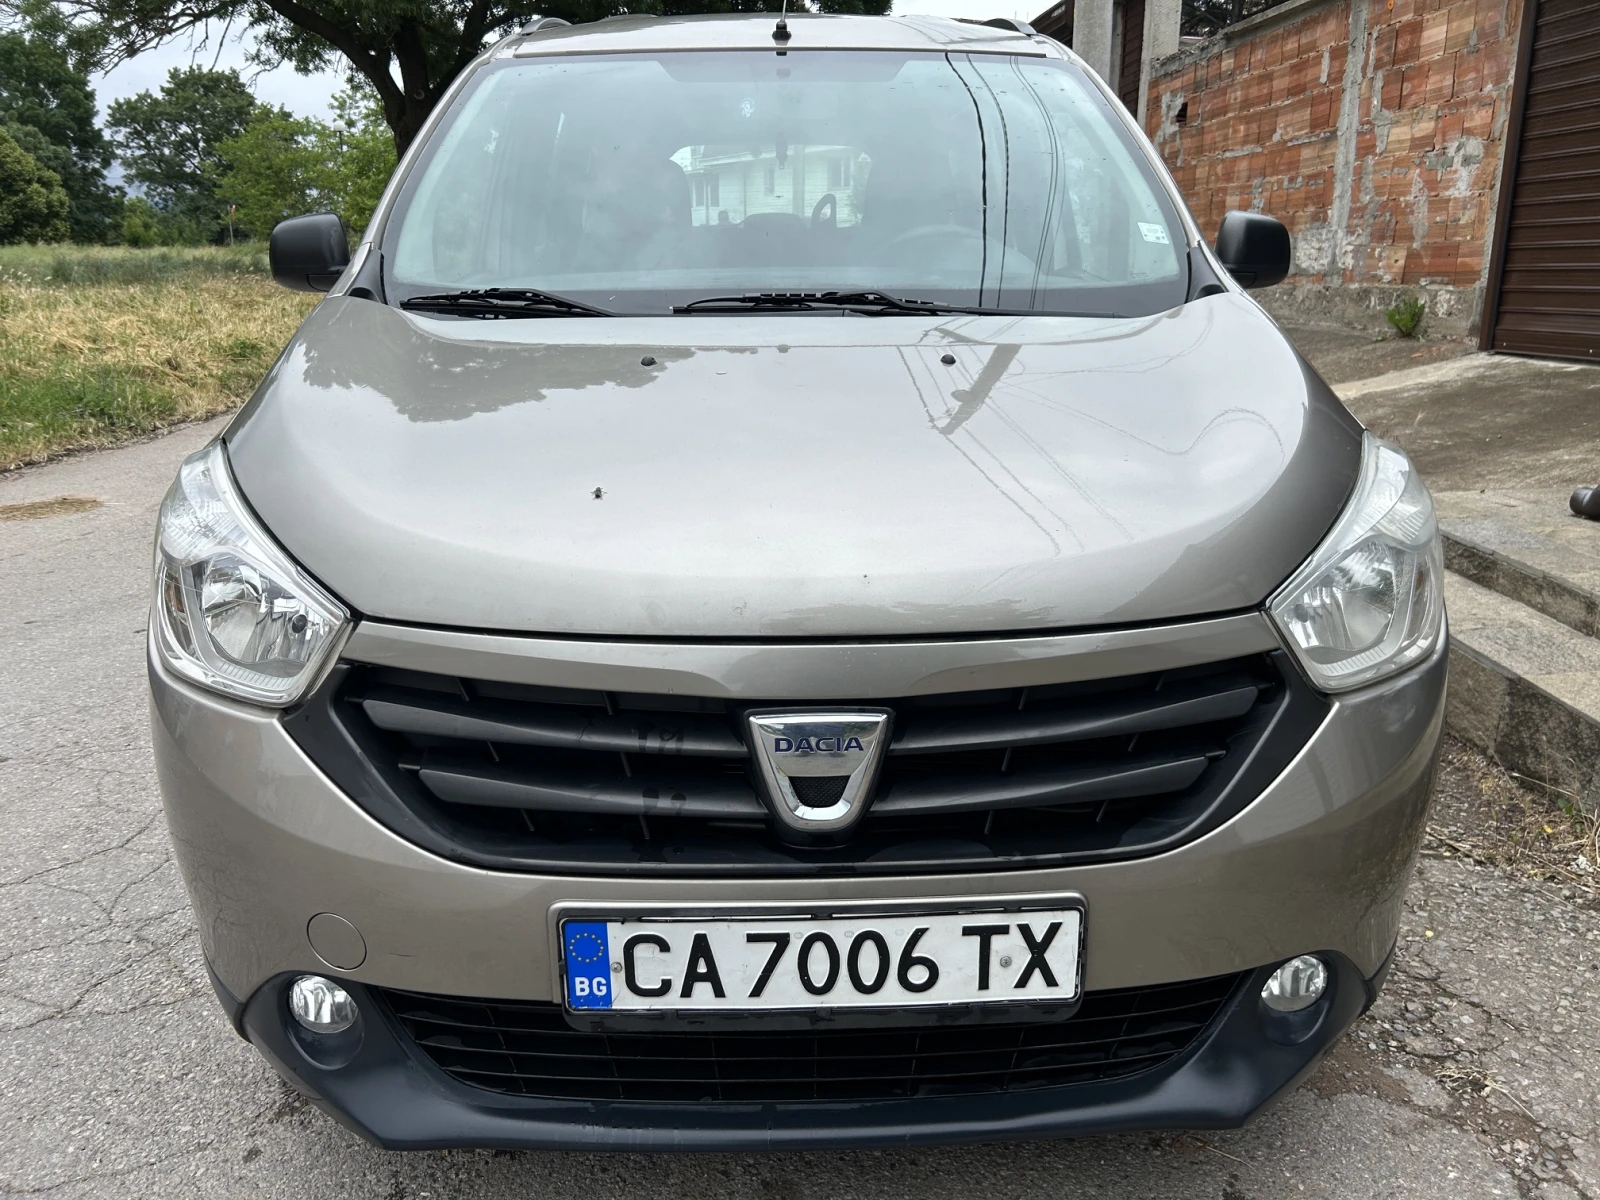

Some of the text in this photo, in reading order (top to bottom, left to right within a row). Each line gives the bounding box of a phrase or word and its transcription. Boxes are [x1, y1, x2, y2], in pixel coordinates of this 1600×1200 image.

[774, 736, 864, 753] DACIA
[622, 921, 1064, 999] CA 7006 TX
[574, 975, 608, 997] BG
